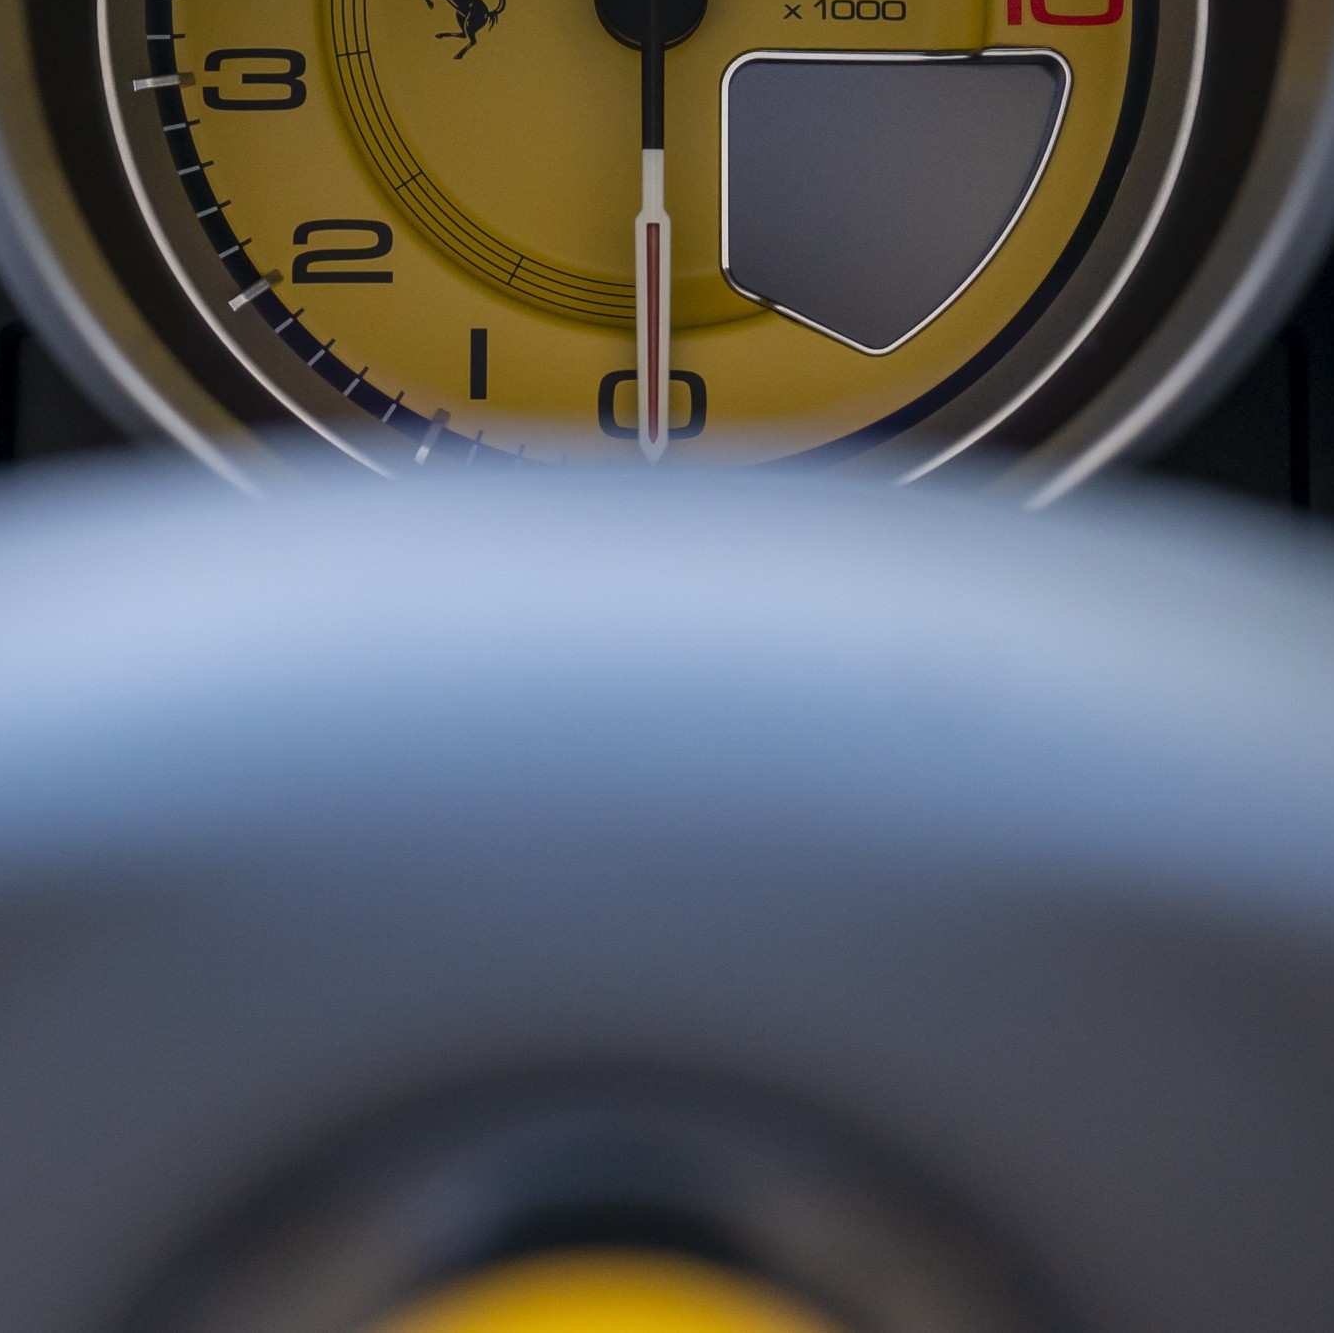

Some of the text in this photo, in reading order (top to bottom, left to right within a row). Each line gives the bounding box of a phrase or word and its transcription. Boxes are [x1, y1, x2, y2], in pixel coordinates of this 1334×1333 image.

[814, 0, 907, 21] 1000
[203, 48, 307, 111] 3
[292, 219, 394, 284] 2
[470, 328, 488, 400] 1
[598, 370, 707, 440] 0
